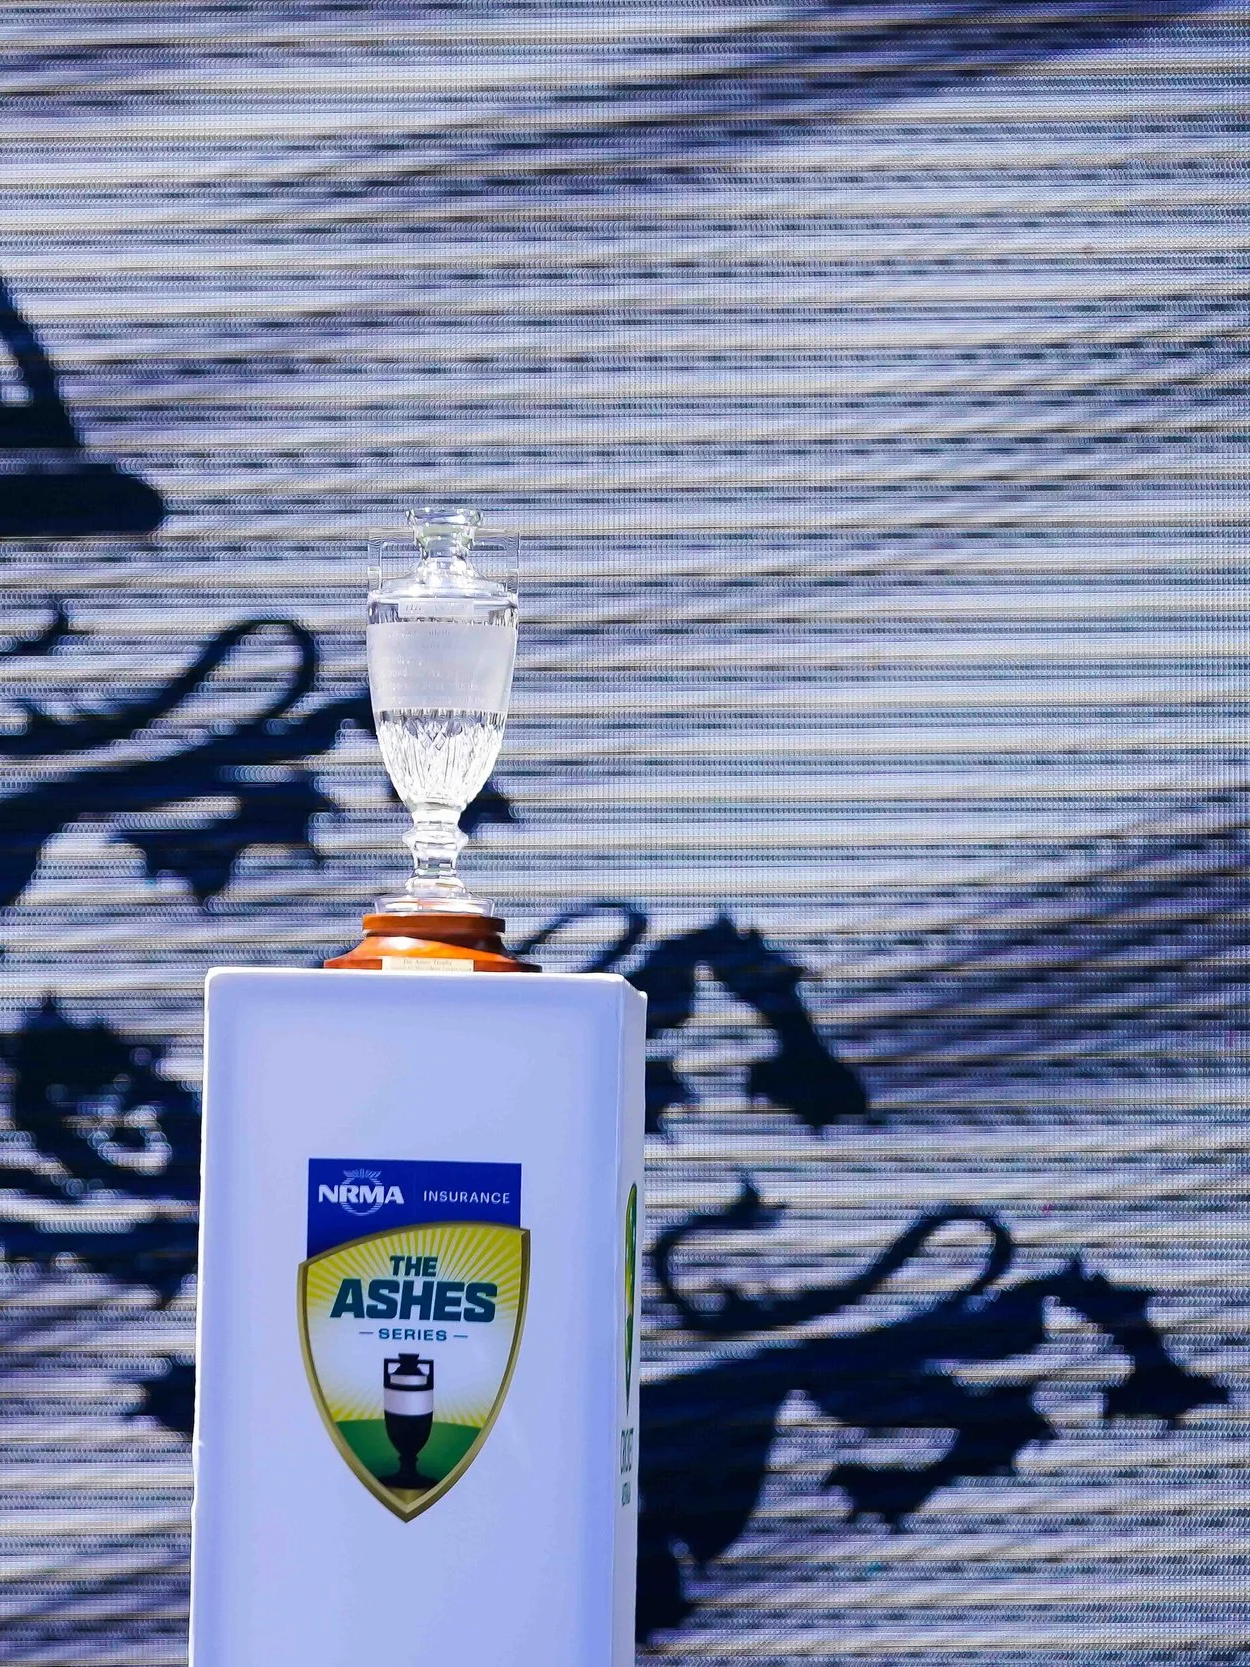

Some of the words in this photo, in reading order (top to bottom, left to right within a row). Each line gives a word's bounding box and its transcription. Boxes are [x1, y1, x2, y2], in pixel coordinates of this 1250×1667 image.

[318, 1184, 405, 1205] NRMA
[423, 1190, 511, 1205] INSURANCE
[389, 1255, 438, 1277] THE
[329, 1278, 498, 1323] ASHES
[378, 1328, 447, 1341] SERIES
